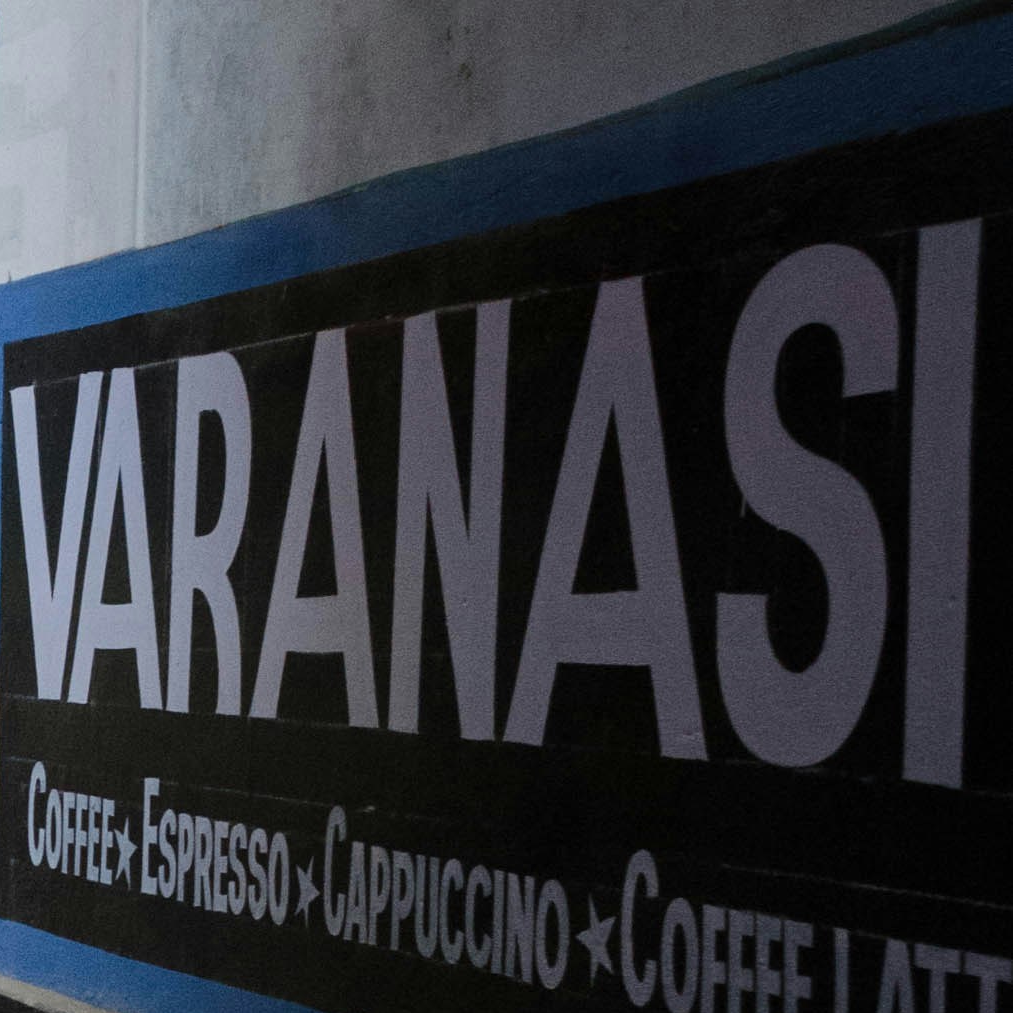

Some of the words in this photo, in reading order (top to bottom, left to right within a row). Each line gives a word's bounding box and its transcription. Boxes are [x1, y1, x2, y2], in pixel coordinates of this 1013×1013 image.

[10, 217, 982, 790] VARANASI
[28, 761, 117, 885] COFFEE
[141, 777, 290, 927] ESPRESSO
[323, 806, 569, 990] CAPPUCCINO
